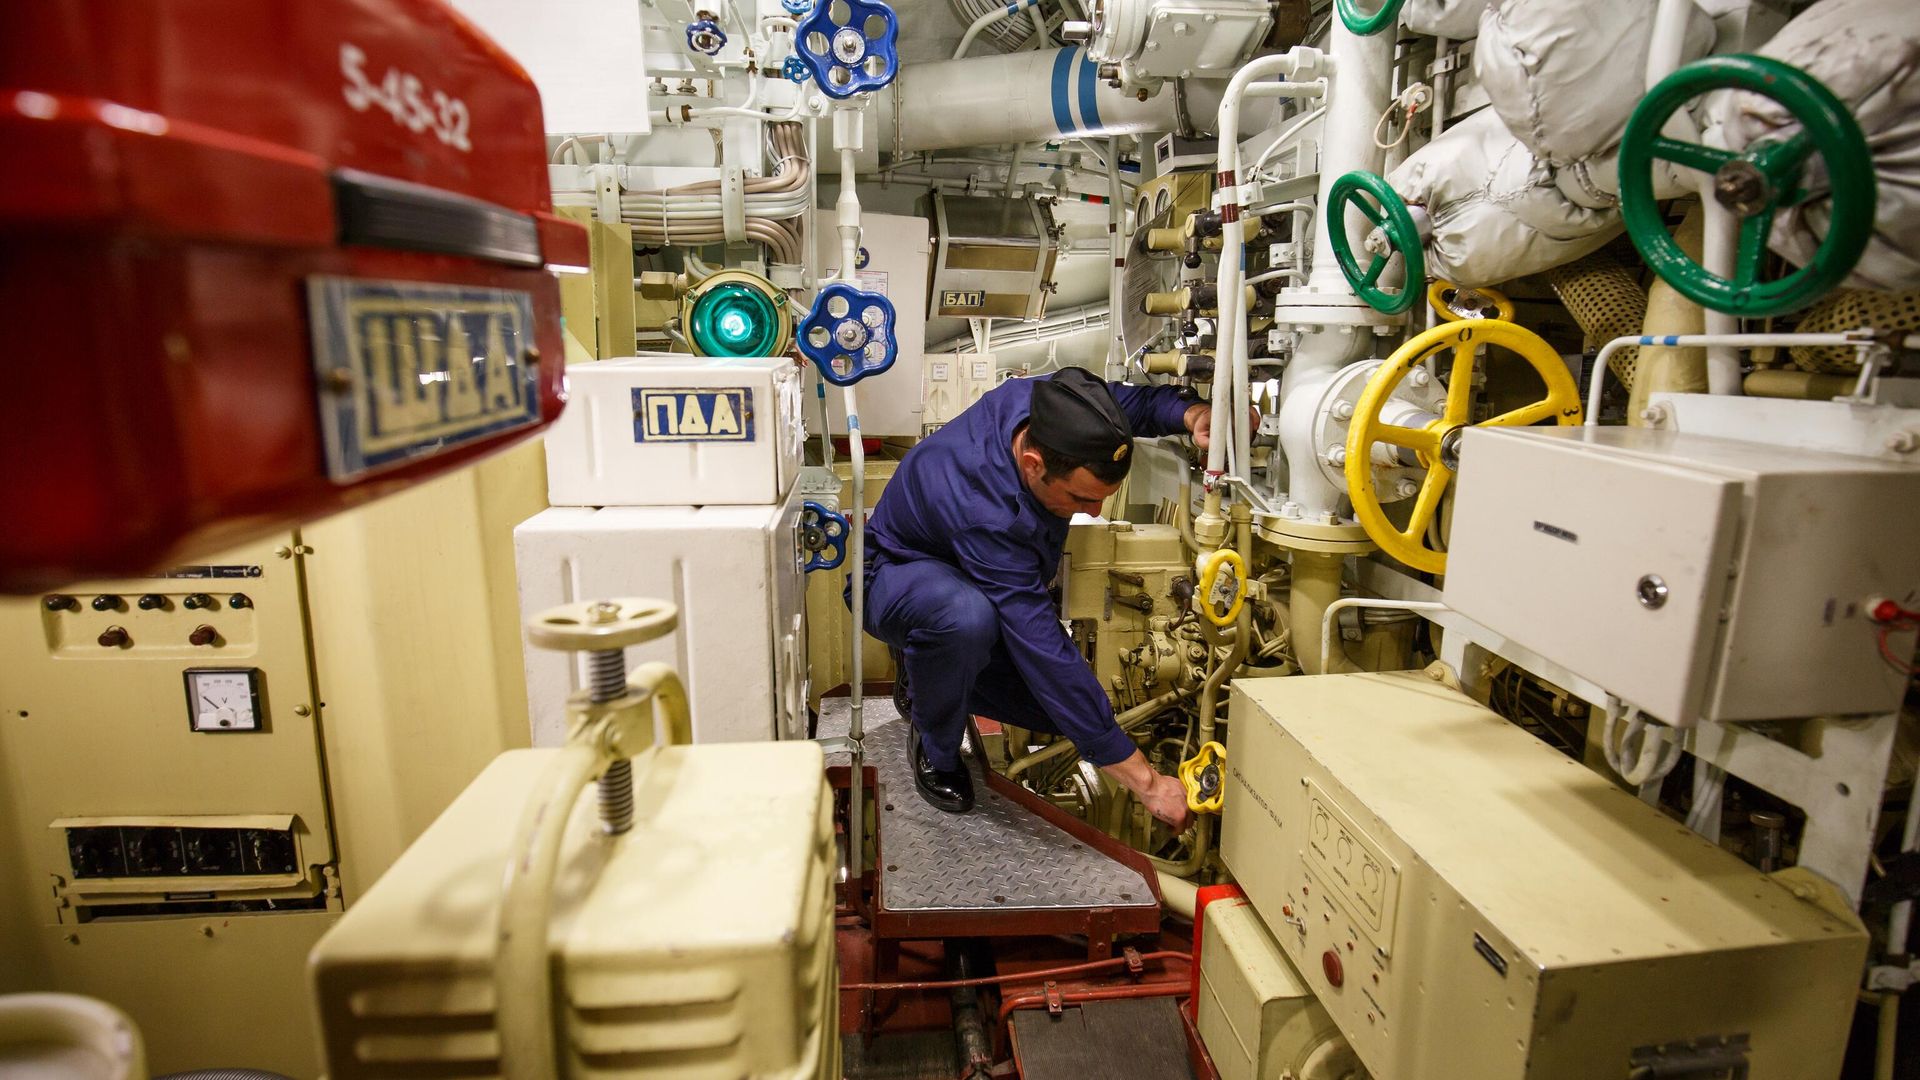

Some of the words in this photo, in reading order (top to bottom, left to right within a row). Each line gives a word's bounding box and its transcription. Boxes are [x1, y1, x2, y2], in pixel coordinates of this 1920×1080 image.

[338, 42, 473, 152] 5-45-32
[946, 293, 979, 305] БАП
[648, 394, 739, 435] ПДА
